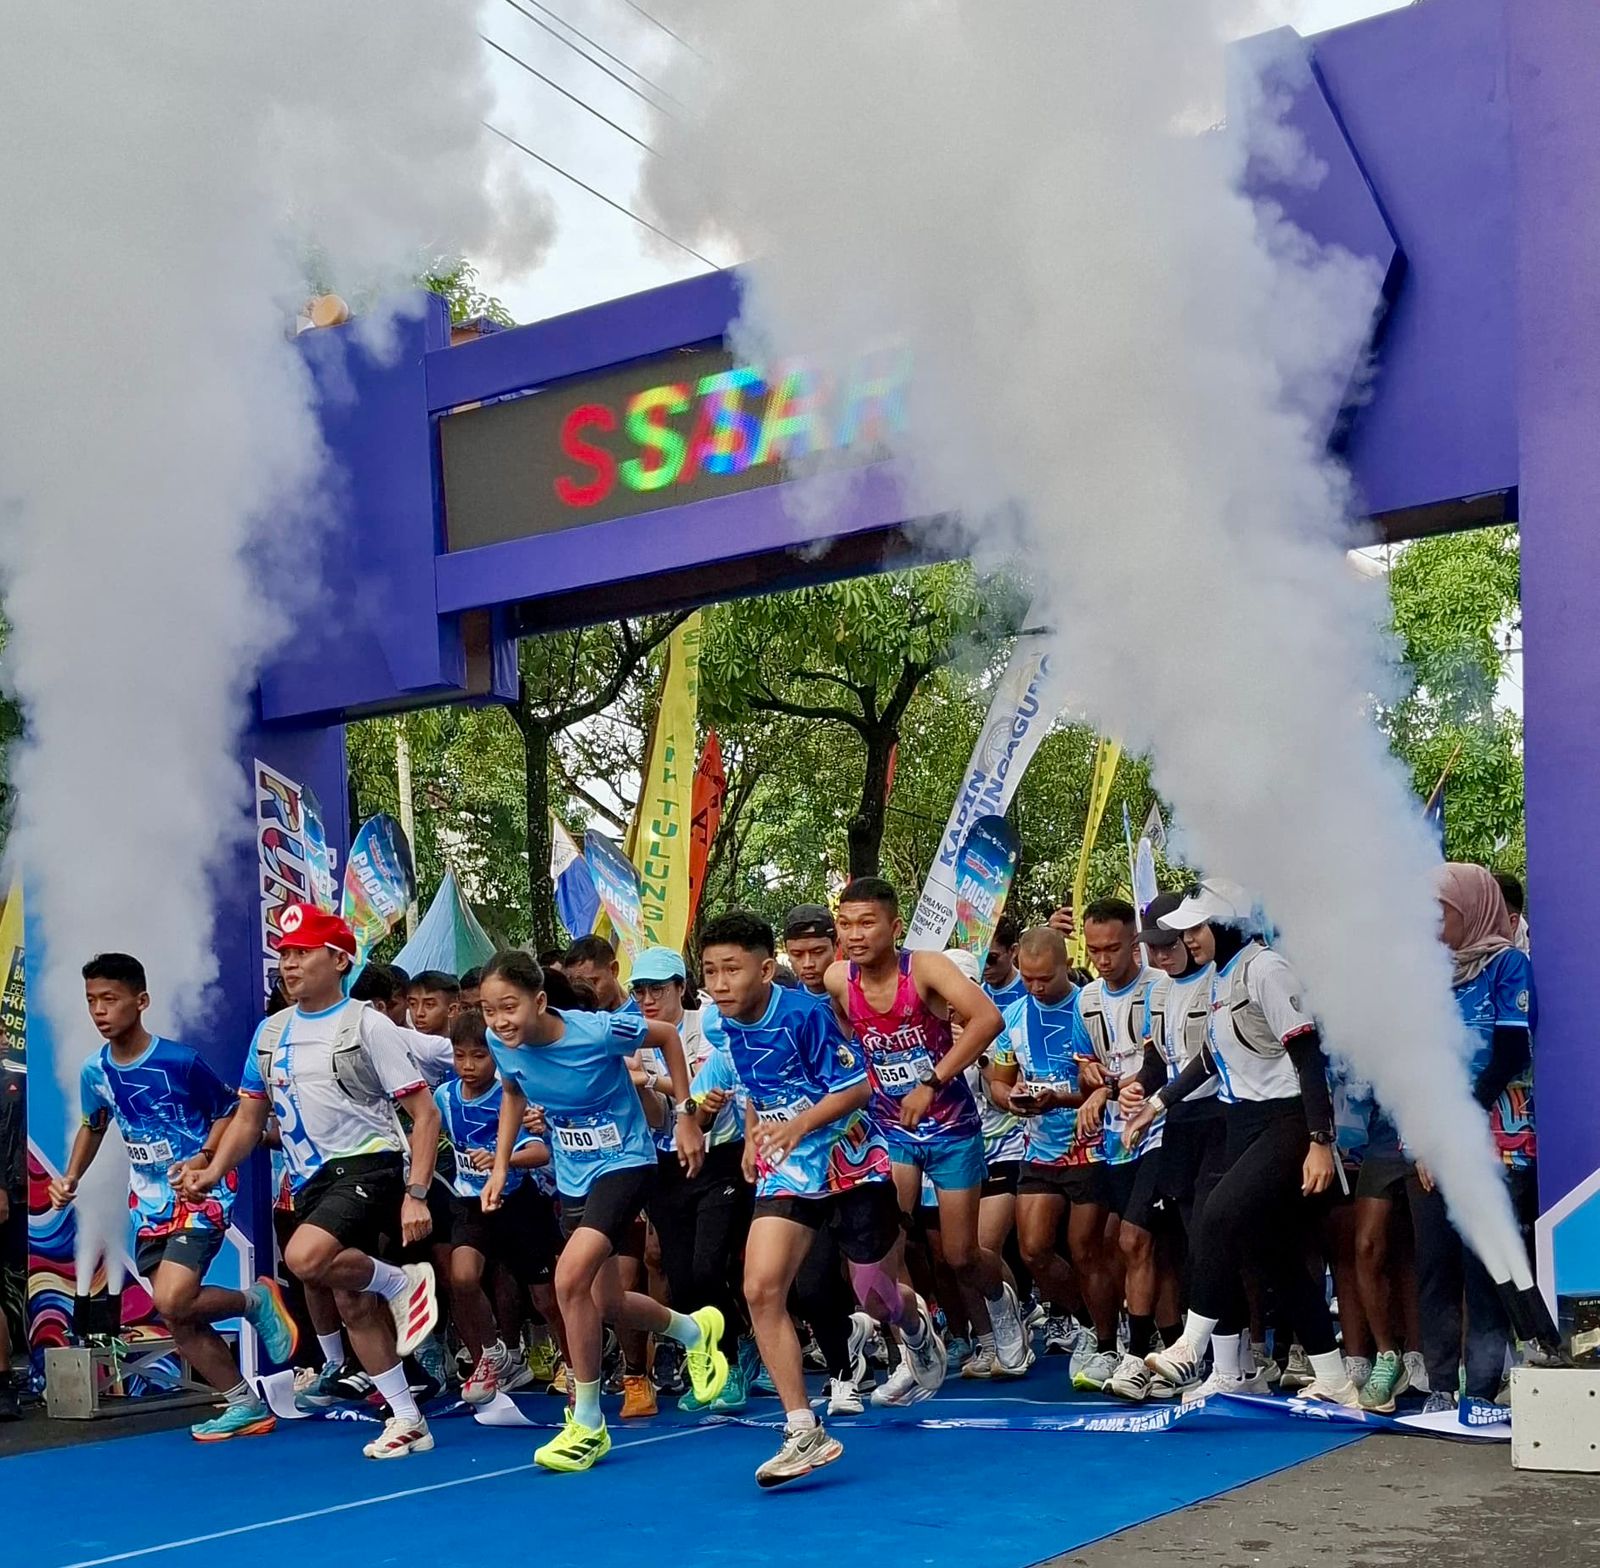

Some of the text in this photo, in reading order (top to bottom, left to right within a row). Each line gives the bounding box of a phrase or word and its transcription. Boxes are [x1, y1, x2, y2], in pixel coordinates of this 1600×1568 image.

[939, 768, 987, 868] KADIN
[353, 850, 396, 918] PACER
[958, 874, 997, 918] PACER
[559, 1130, 593, 1147] 0760
